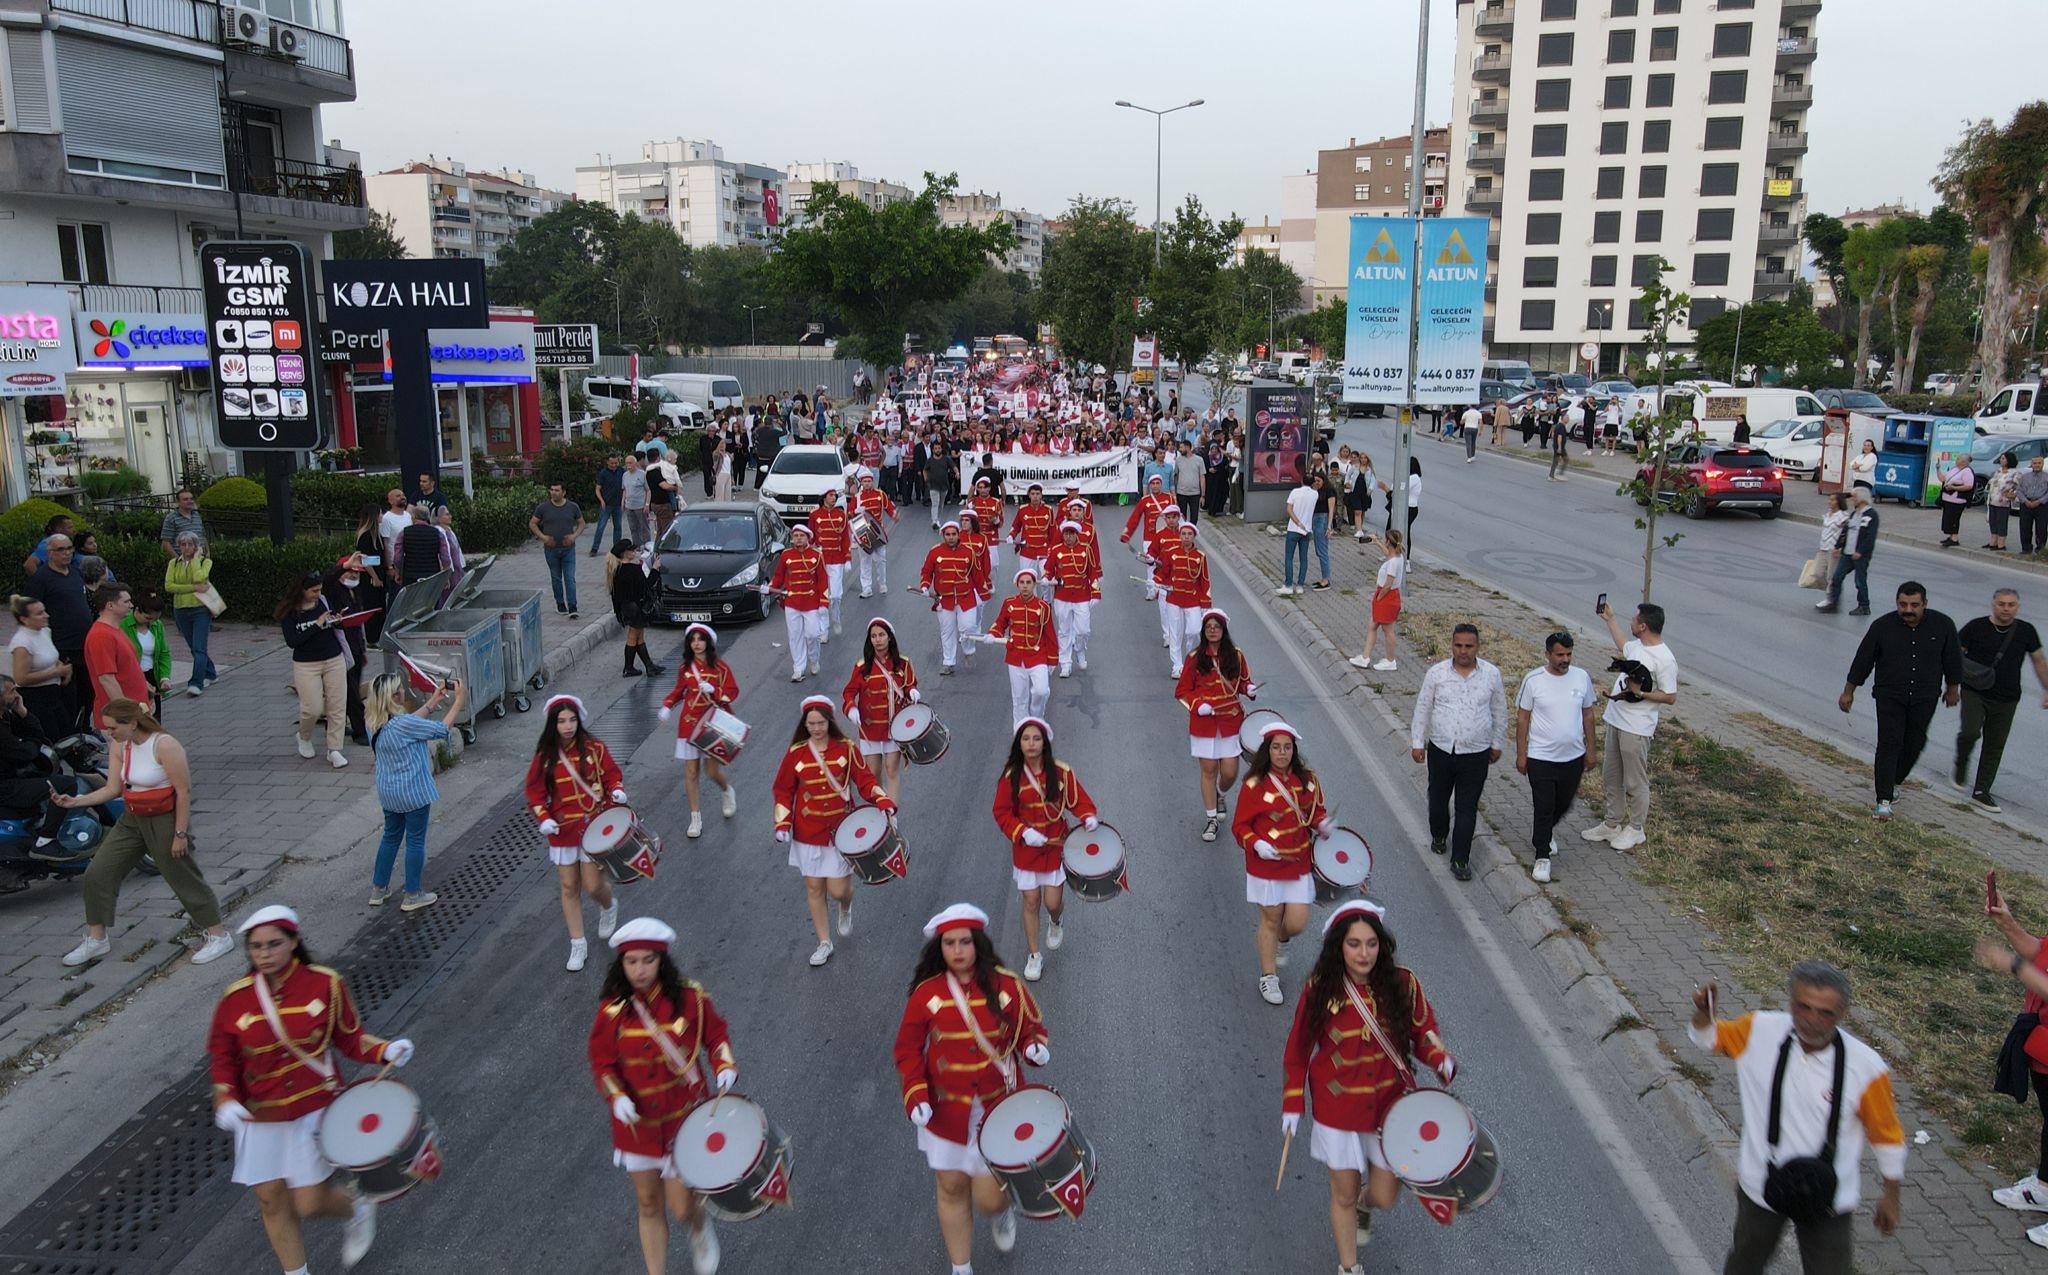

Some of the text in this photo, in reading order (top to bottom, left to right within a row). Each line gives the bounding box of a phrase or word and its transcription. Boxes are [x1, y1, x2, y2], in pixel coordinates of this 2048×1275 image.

[213, 257, 291, 284] İZMİR
[1354, 266, 1406, 281] ALTUN
[1426, 267, 1478, 282] ALTUN
[227, 286, 286, 305] GSM
[333, 281, 471, 307] KOZA HALI
[230, 308, 289, 316] 0850 850 1 476
[1358, 306, 1400, 314] GELECEĞİN
[1430, 307, 1472, 315] GELECEĞİN
[1360, 315, 1398, 323] YÜKSELEN
[1432, 316, 1471, 324] YÜKSELEN
[558, 326, 591, 347] Perde
[0, 342, 38, 361] İLİM
[552, 355, 565, 363] 713
[577, 355, 587, 363] 05
[1349, 367, 1403, 379] 444 0 837
[1420, 369, 1475, 380] 444 0 837
[1348, 382, 1402, 392] www.altunyap.com
[1420, 384, 1474, 393] www.altunyap.com
[1010, 466, 1049, 480] ÜMİDİM
[1052, 464, 1120, 481] GENÇLİKTEDİR!
